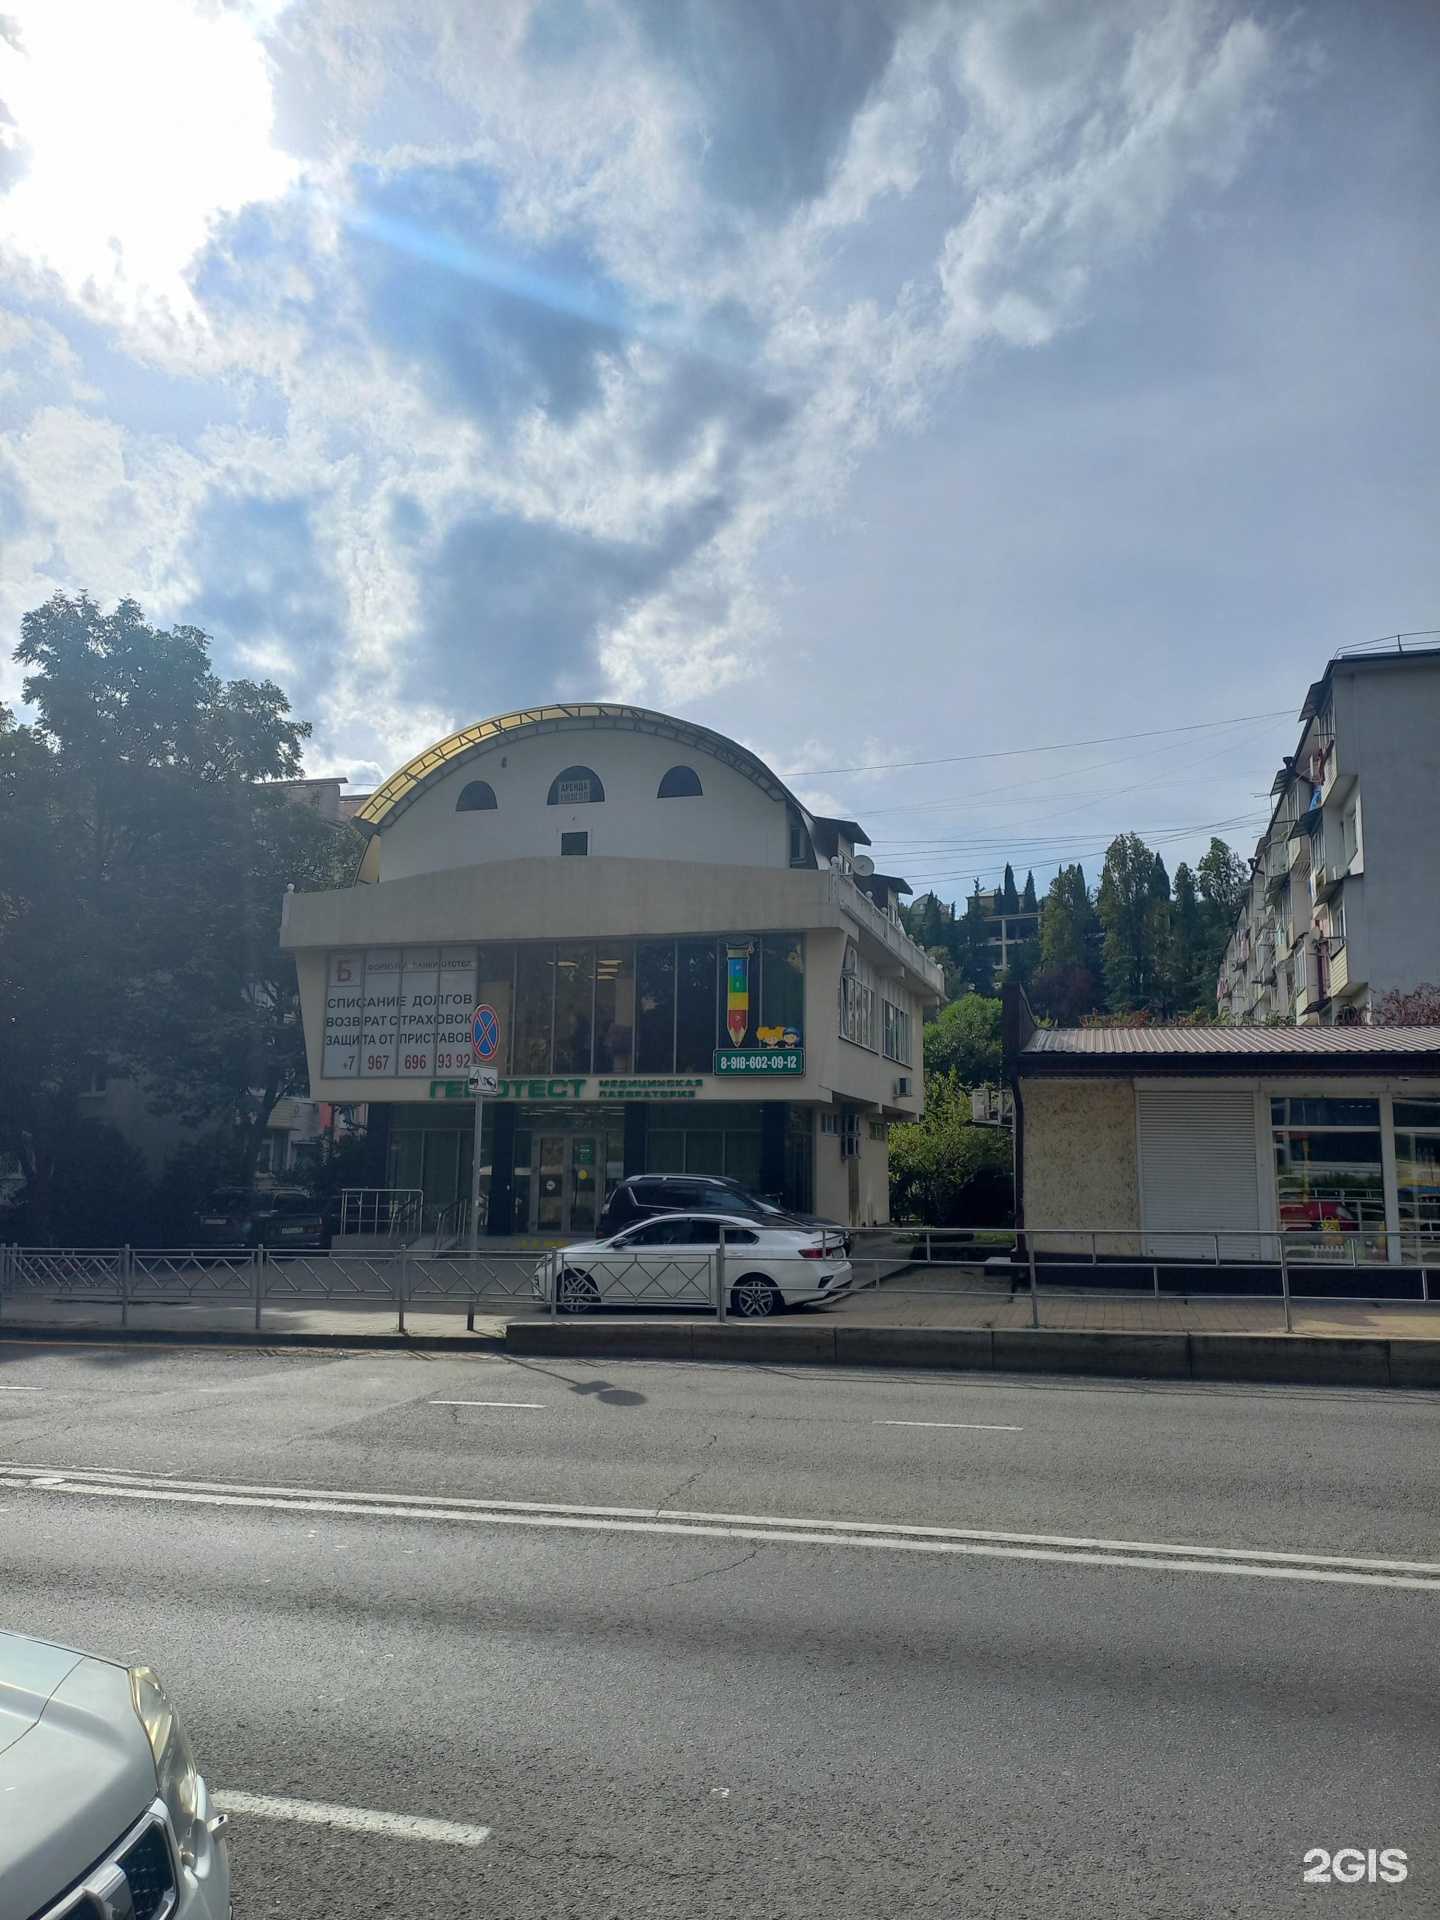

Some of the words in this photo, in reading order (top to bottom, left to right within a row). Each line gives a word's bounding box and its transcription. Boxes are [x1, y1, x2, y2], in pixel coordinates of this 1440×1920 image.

[327, 996, 407, 1009] СПИСАНИЕ
[412, 994, 473, 1007] ДОЛГОВ
[326, 1015, 387, 1027] ВОЗВРАТ
[389, 1014, 472, 1026] СТРАХОВОК
[326, 1034, 377, 1046] ЗАЩИТА
[378, 1034, 395, 1045] ОТ
[399, 1032, 471, 1044] ПРИСТАВОВ
[367, 1055, 389, 1070] 967
[404, 1054, 427, 1070] 696
[437, 1054, 451, 1069] 93
[456, 1053, 471, 1068] 92
[720, 1056, 797, 1069] 8-918-602-09-12
[430, 1079, 587, 1098] ГЕОТЕСТ
